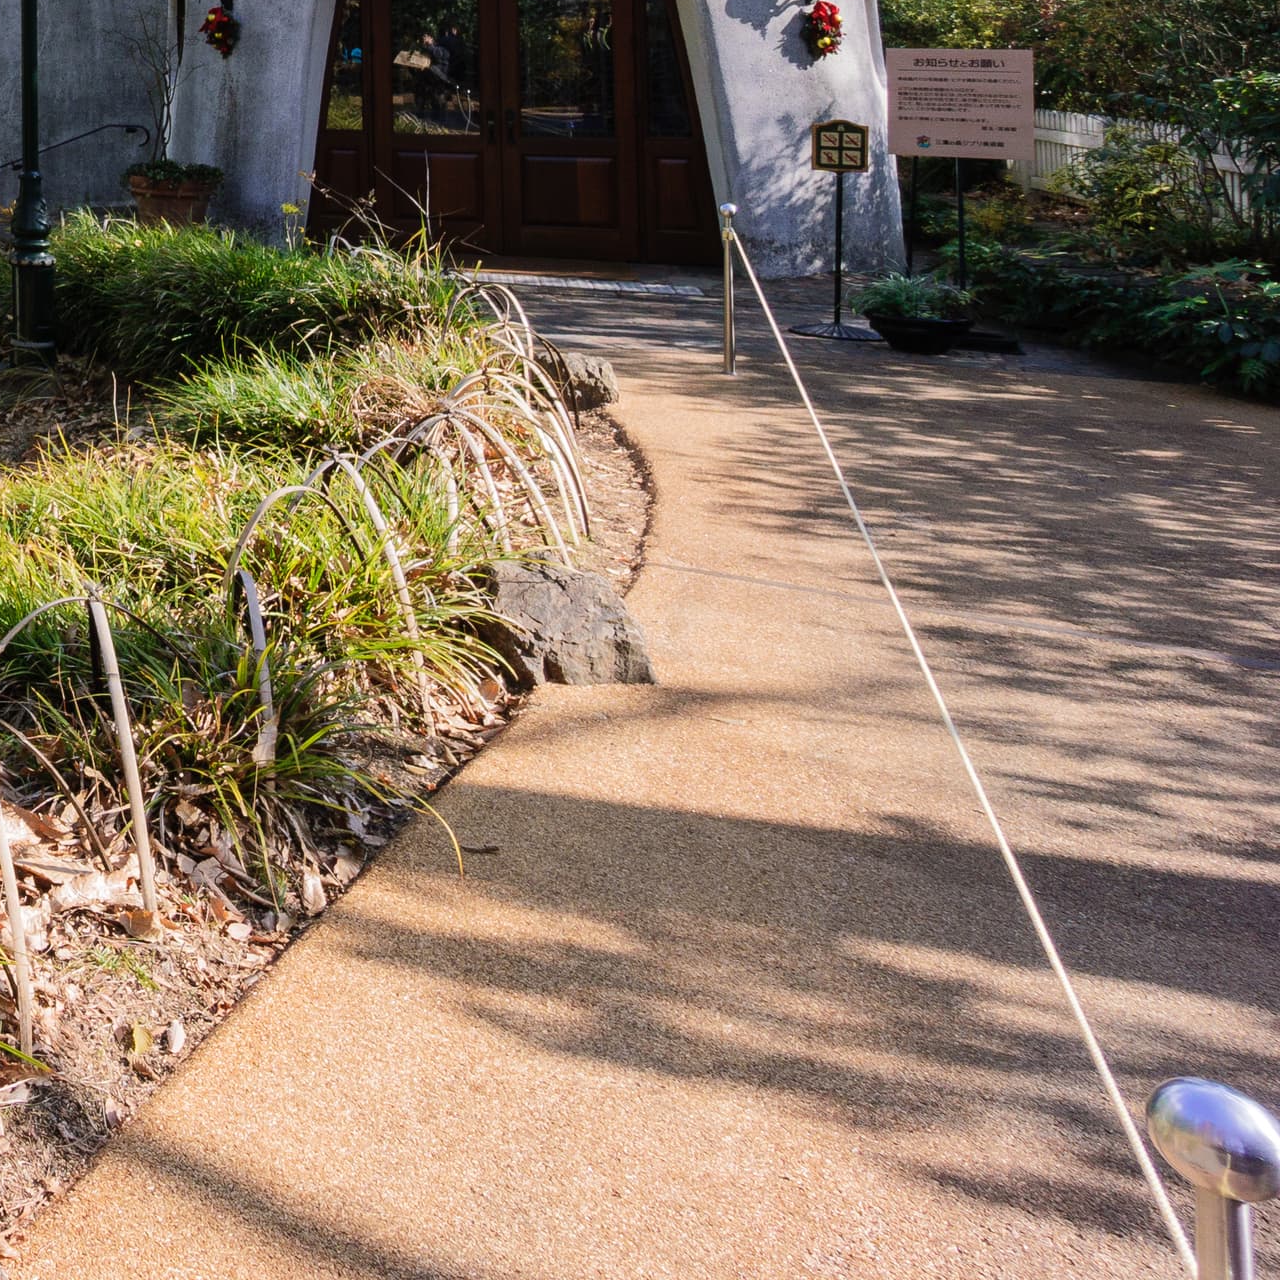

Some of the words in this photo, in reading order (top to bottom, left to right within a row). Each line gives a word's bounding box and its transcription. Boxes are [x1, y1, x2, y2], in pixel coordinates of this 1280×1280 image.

[912, 57, 1006, 69] お知らせとお願い
